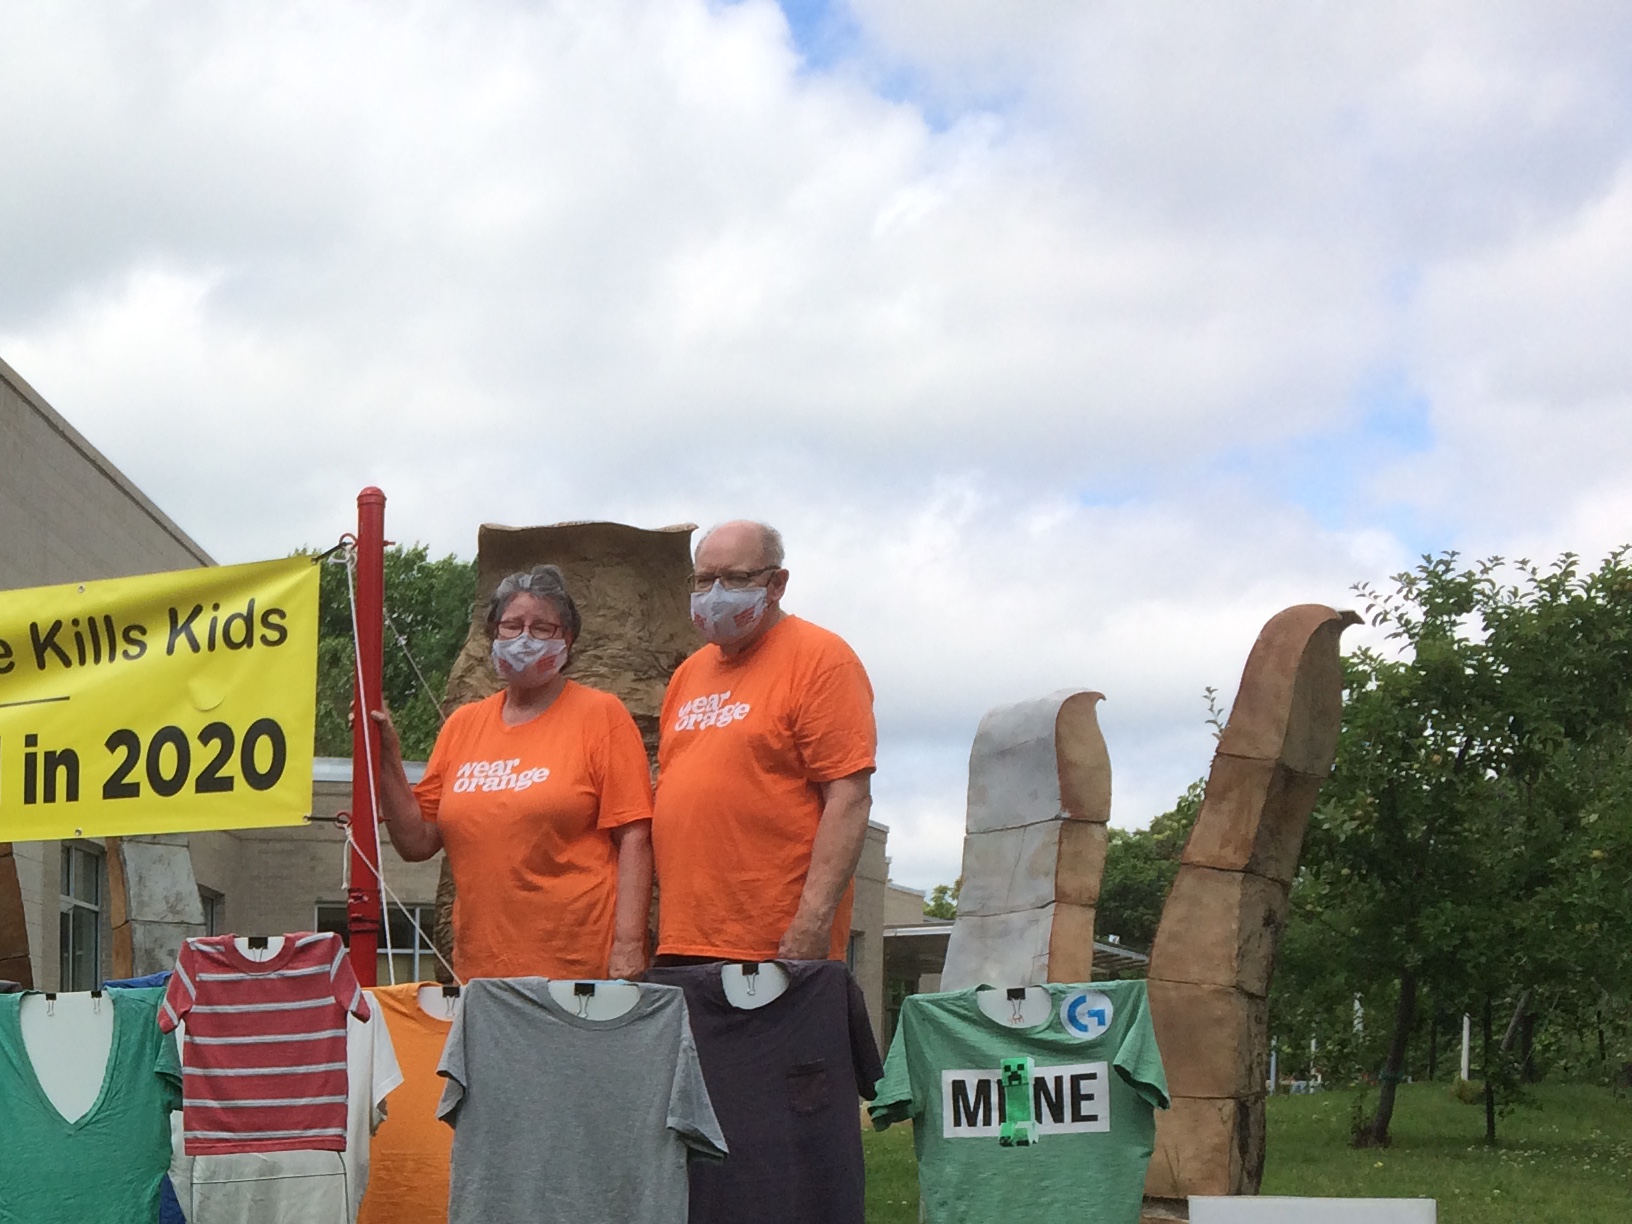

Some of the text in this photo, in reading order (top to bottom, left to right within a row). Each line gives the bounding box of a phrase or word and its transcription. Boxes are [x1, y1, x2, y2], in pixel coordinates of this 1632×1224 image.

[28, 612, 148, 671] Kills
[166, 598, 289, 656] Kids
[674, 701, 750, 731] orage
[23, 733, 81, 805] in
[101, 717, 288, 800] 2020
[456, 758, 521, 778] wear
[453, 767, 550, 793] orange
